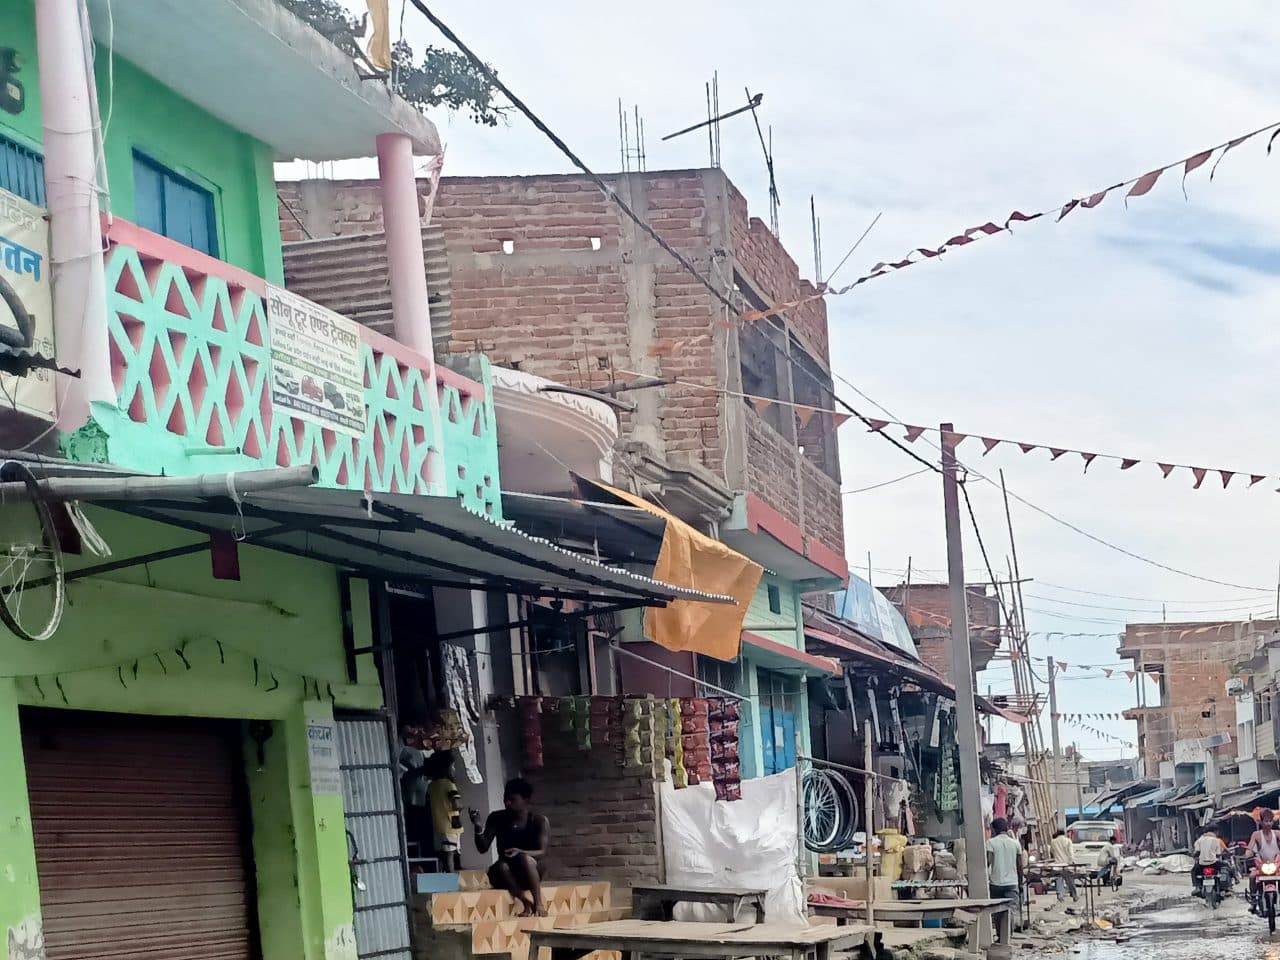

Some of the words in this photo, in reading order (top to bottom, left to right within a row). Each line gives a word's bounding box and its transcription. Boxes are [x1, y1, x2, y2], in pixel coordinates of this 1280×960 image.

[0, 235, 42, 282] तन
[270, 295, 295, 329] सोनू
[294, 308, 307, 333] टूर
